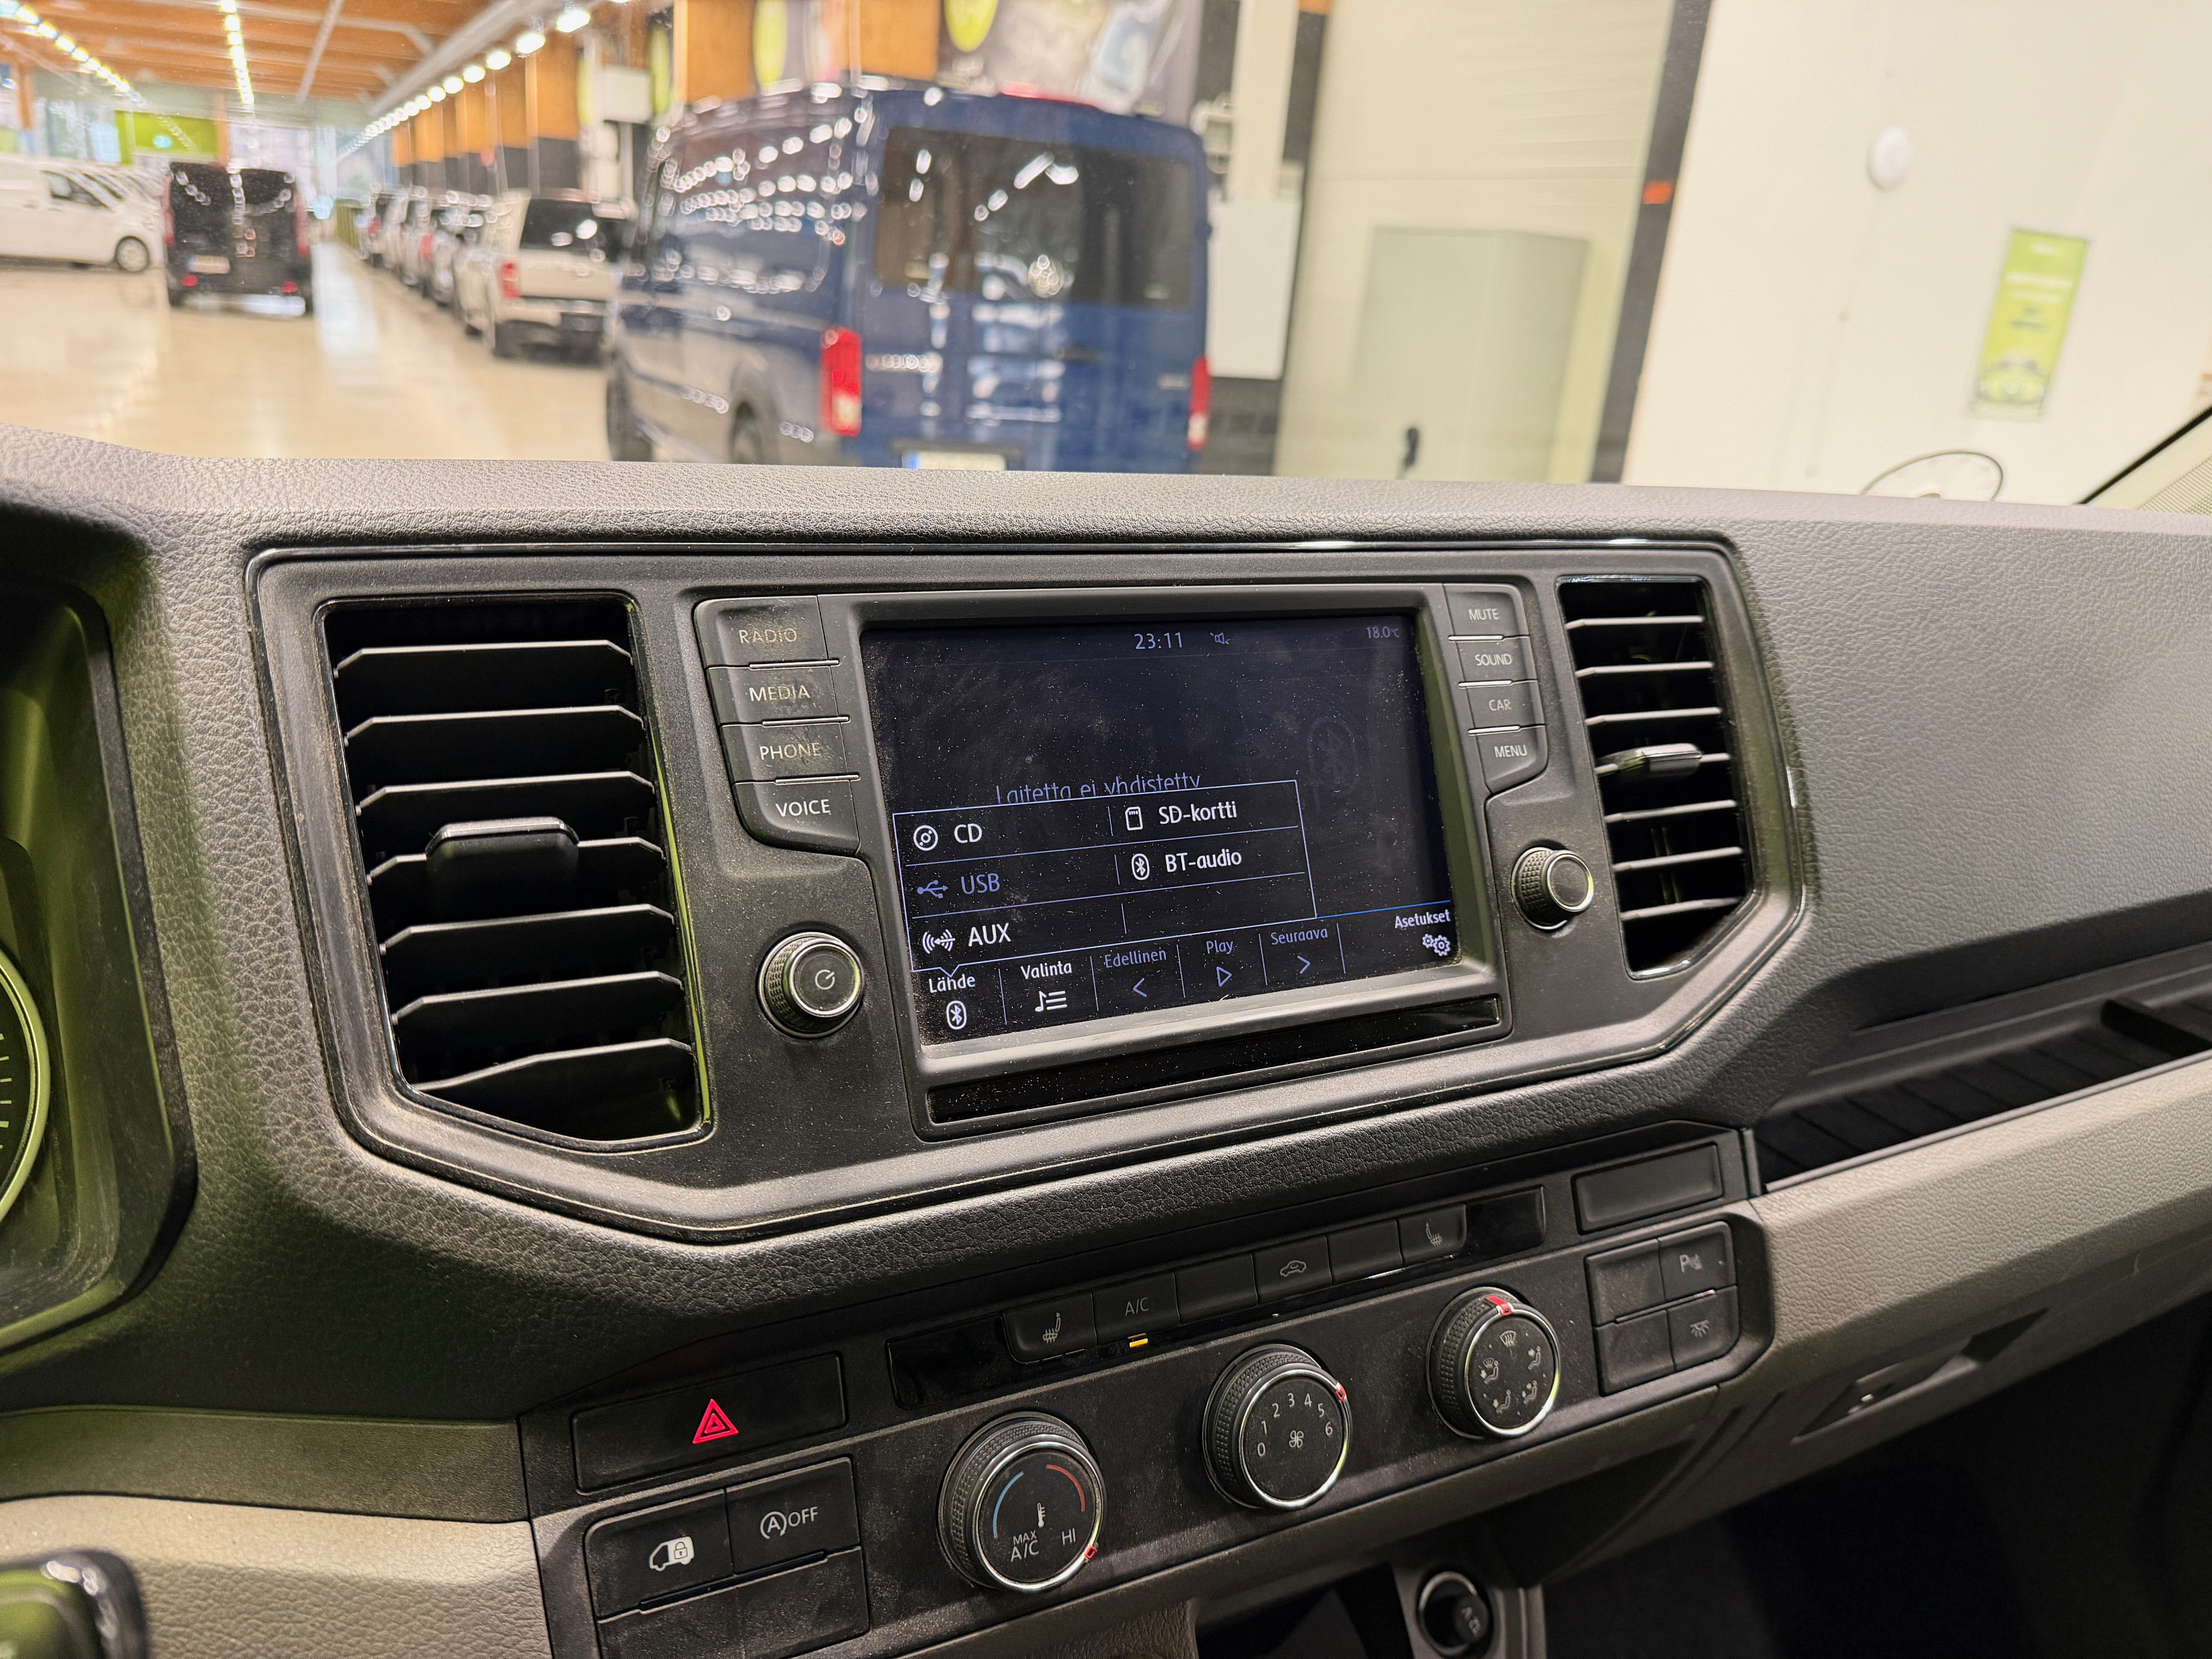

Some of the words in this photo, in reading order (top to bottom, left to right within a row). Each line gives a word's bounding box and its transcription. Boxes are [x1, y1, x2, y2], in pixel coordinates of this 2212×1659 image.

[1468, 608, 1499, 622] MUTE
[739, 628, 797, 644] RADIO
[1135, 632, 1183, 650] 23:11
[1475, 653, 1512, 666] SOUND
[749, 685, 810, 701] MEDIA
[1488, 699, 1511, 712] CAR
[759, 744, 821, 760] PHONE
[1494, 744, 1528, 759] MENU
[775, 799, 831, 817] VOICE
[1159, 801, 1237, 824] SD-kortti
[954, 823, 982, 843] CD
[1165, 848, 1242, 872] BT-audio
[960, 873, 1000, 895] USB
[1394, 909, 1450, 929] Asetukset
[968, 922, 1012, 947] AUX
[1271, 927, 1328, 946] Seuraava
[1206, 939, 1234, 955] Play
[1104, 950, 1167, 969] Edellinen
[1020, 960, 1072, 979] Valinta
[928, 974, 976, 993] Lähde
[1125, 1297, 1149, 1317] A/C
[1287, 1393, 1295, 1407] 3
[1304, 1393, 1312, 1407] 4
[1272, 1403, 1280, 1418] 2
[1318, 1403, 1325, 1417] 5
[1261, 1420, 1267, 1434] 1
[1325, 1422, 1333, 1436] 6
[1257, 1442, 1266, 1456] 0
[788, 1506, 819, 1527] OFF
[1013, 1530, 1037, 1546] MAX
[1061, 1528, 1076, 1546] HI
[1010, 1540, 1039, 1562] A/C
